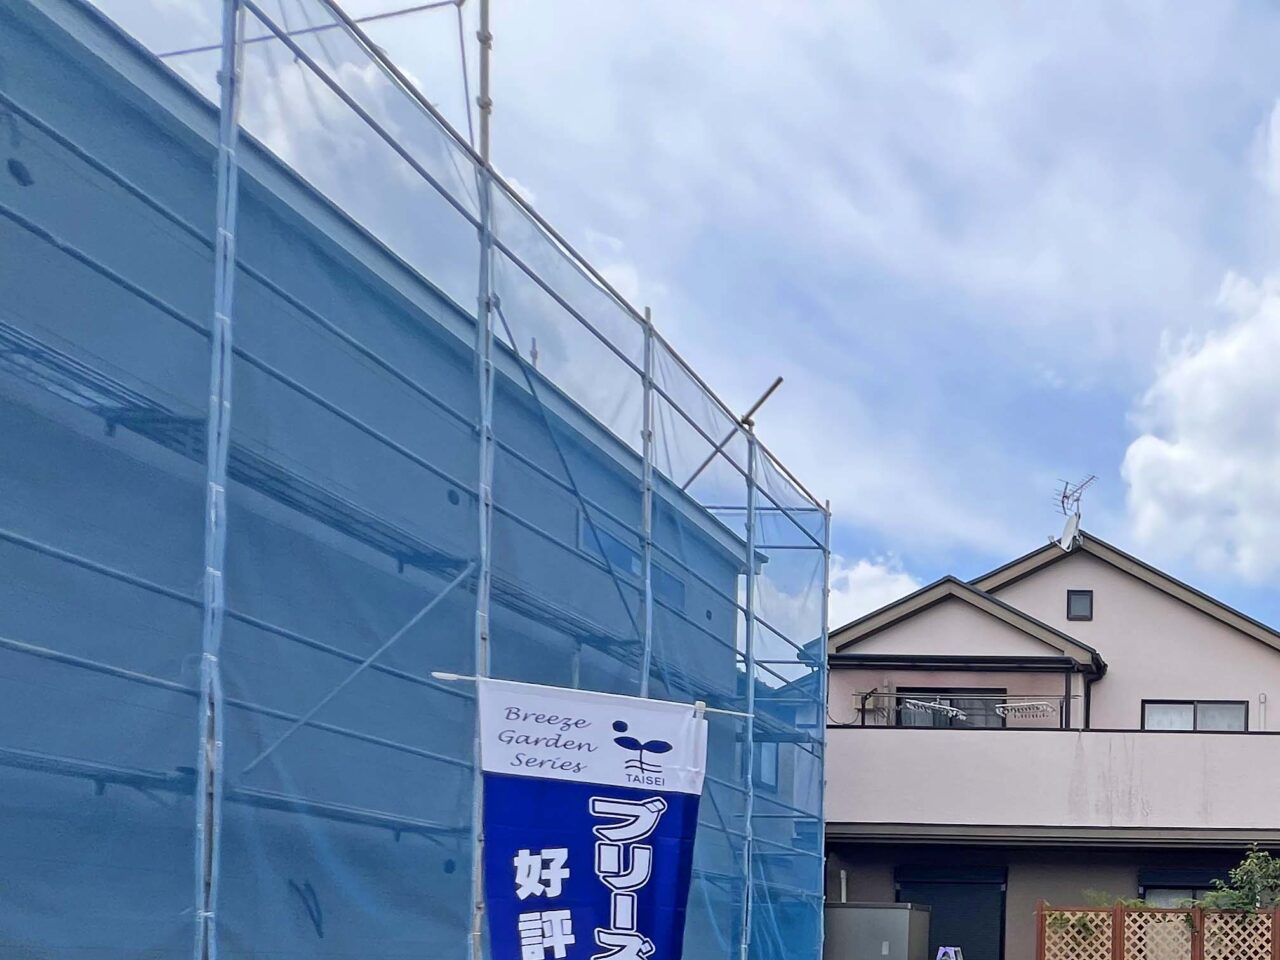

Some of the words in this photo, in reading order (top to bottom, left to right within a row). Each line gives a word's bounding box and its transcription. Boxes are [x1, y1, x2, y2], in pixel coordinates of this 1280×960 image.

[504, 706, 592, 731] Breeze
[498, 729, 598, 752] Garden
[510, 752, 588, 774] Series
[625, 773, 665, 786] TAISEI
